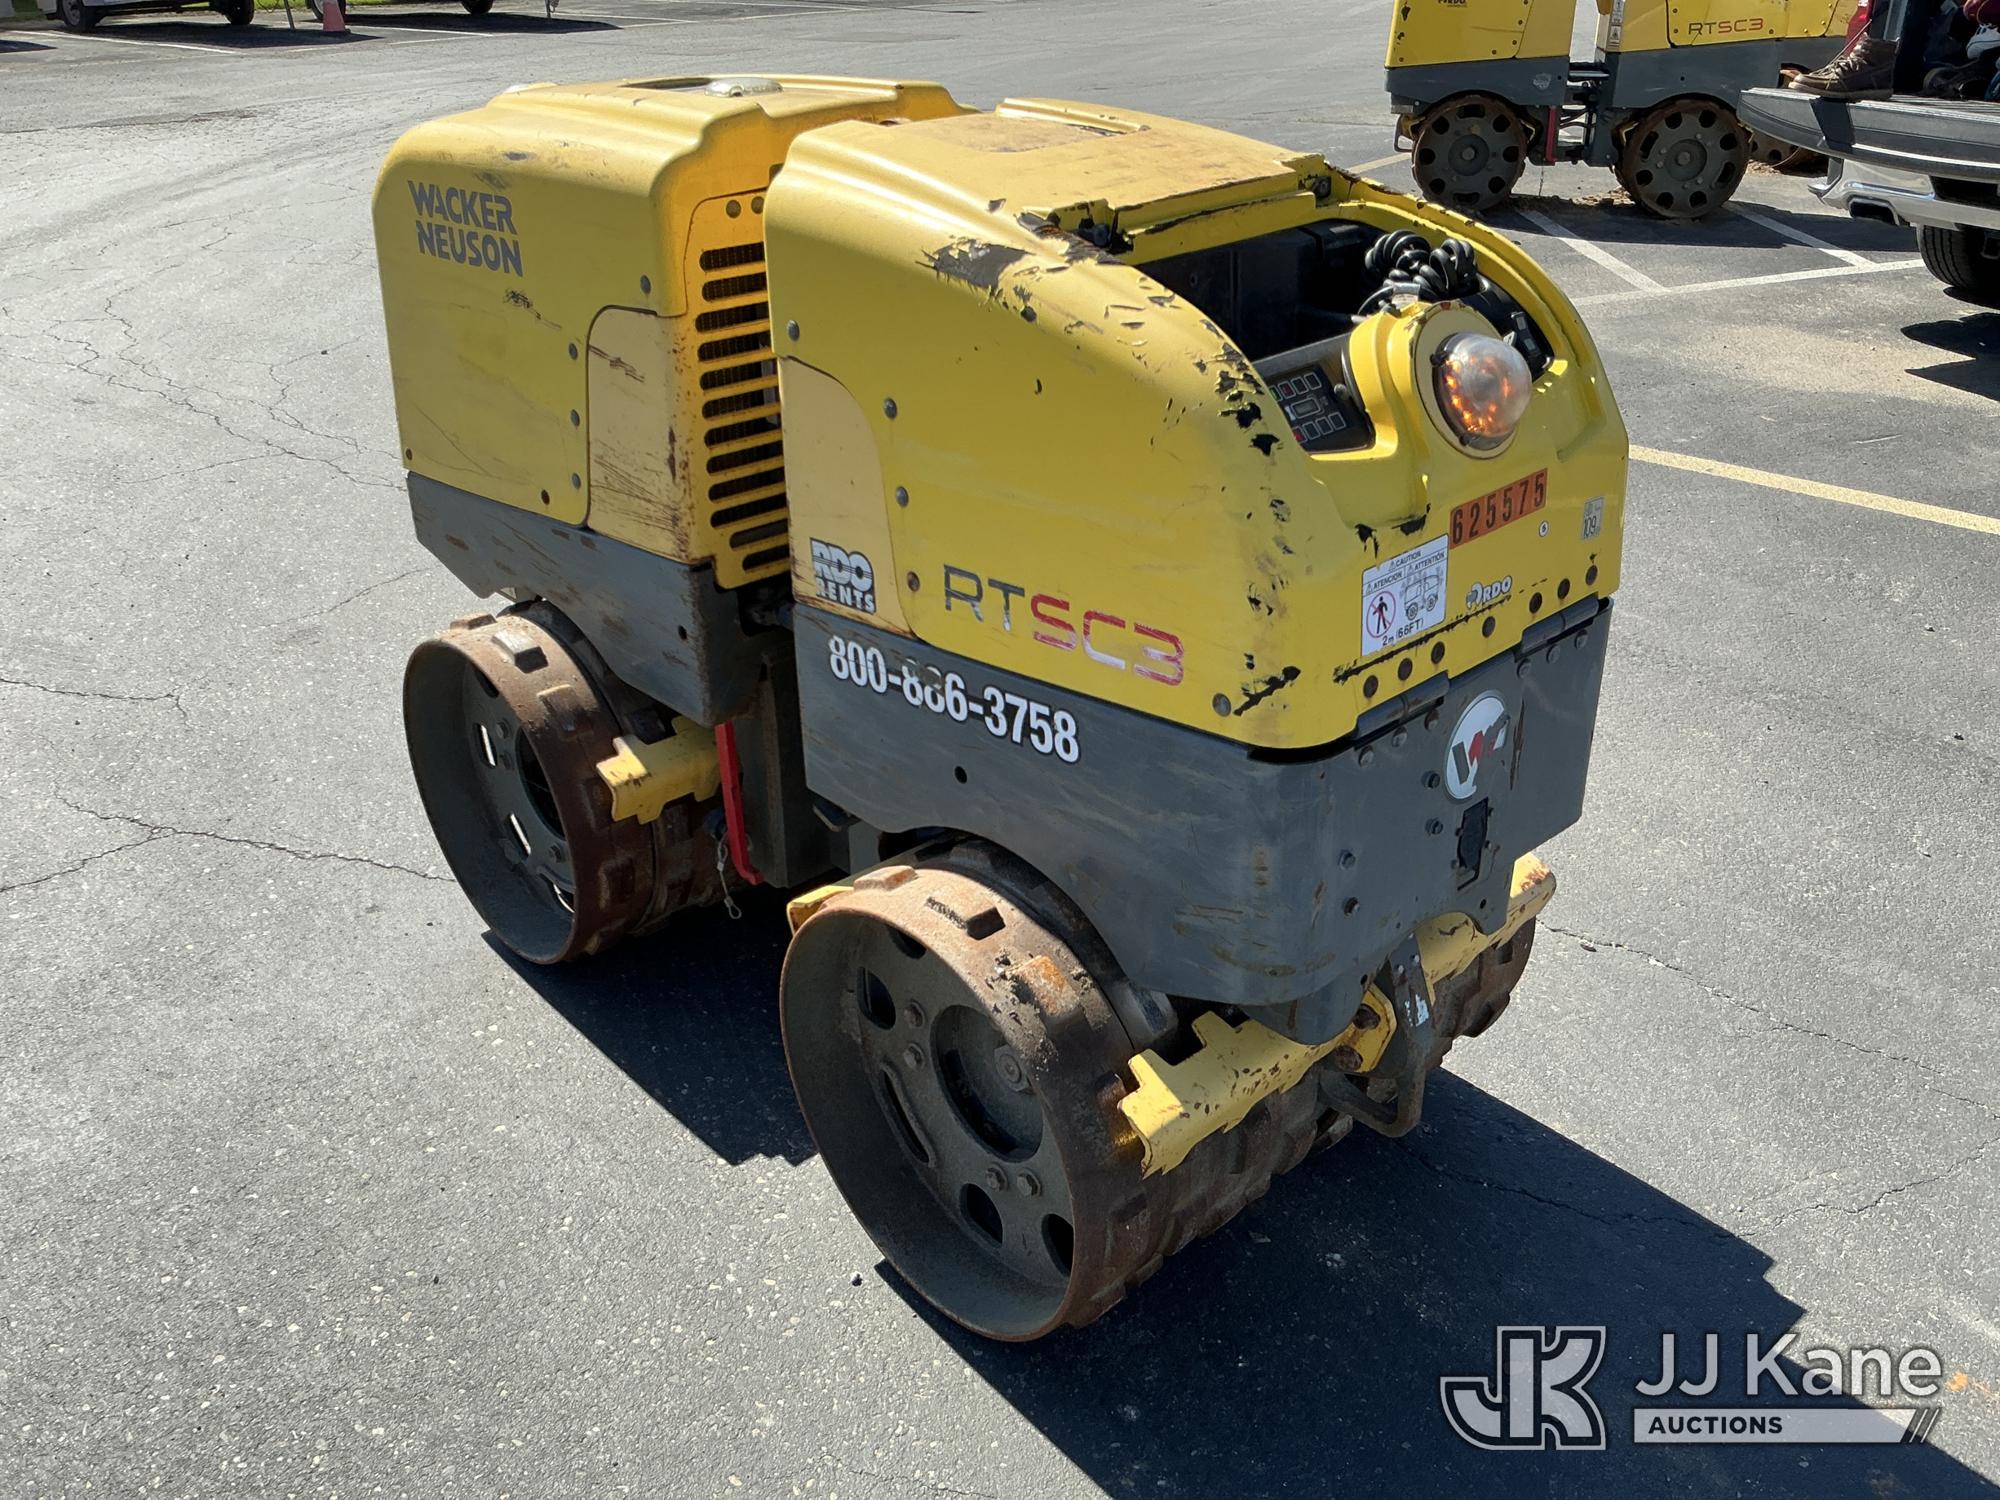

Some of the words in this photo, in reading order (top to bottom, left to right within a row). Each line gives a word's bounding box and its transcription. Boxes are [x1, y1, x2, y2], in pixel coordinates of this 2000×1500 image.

[1688, 18, 1764, 35] RTSC3
[408, 180, 517, 235] WACKER
[415, 220, 523, 277] NEUSON
[1452, 472, 1545, 545] 625575
[810, 537, 874, 593] RDO
[815, 577, 876, 613] RENTS
[943, 563, 1185, 687] RTSC3
